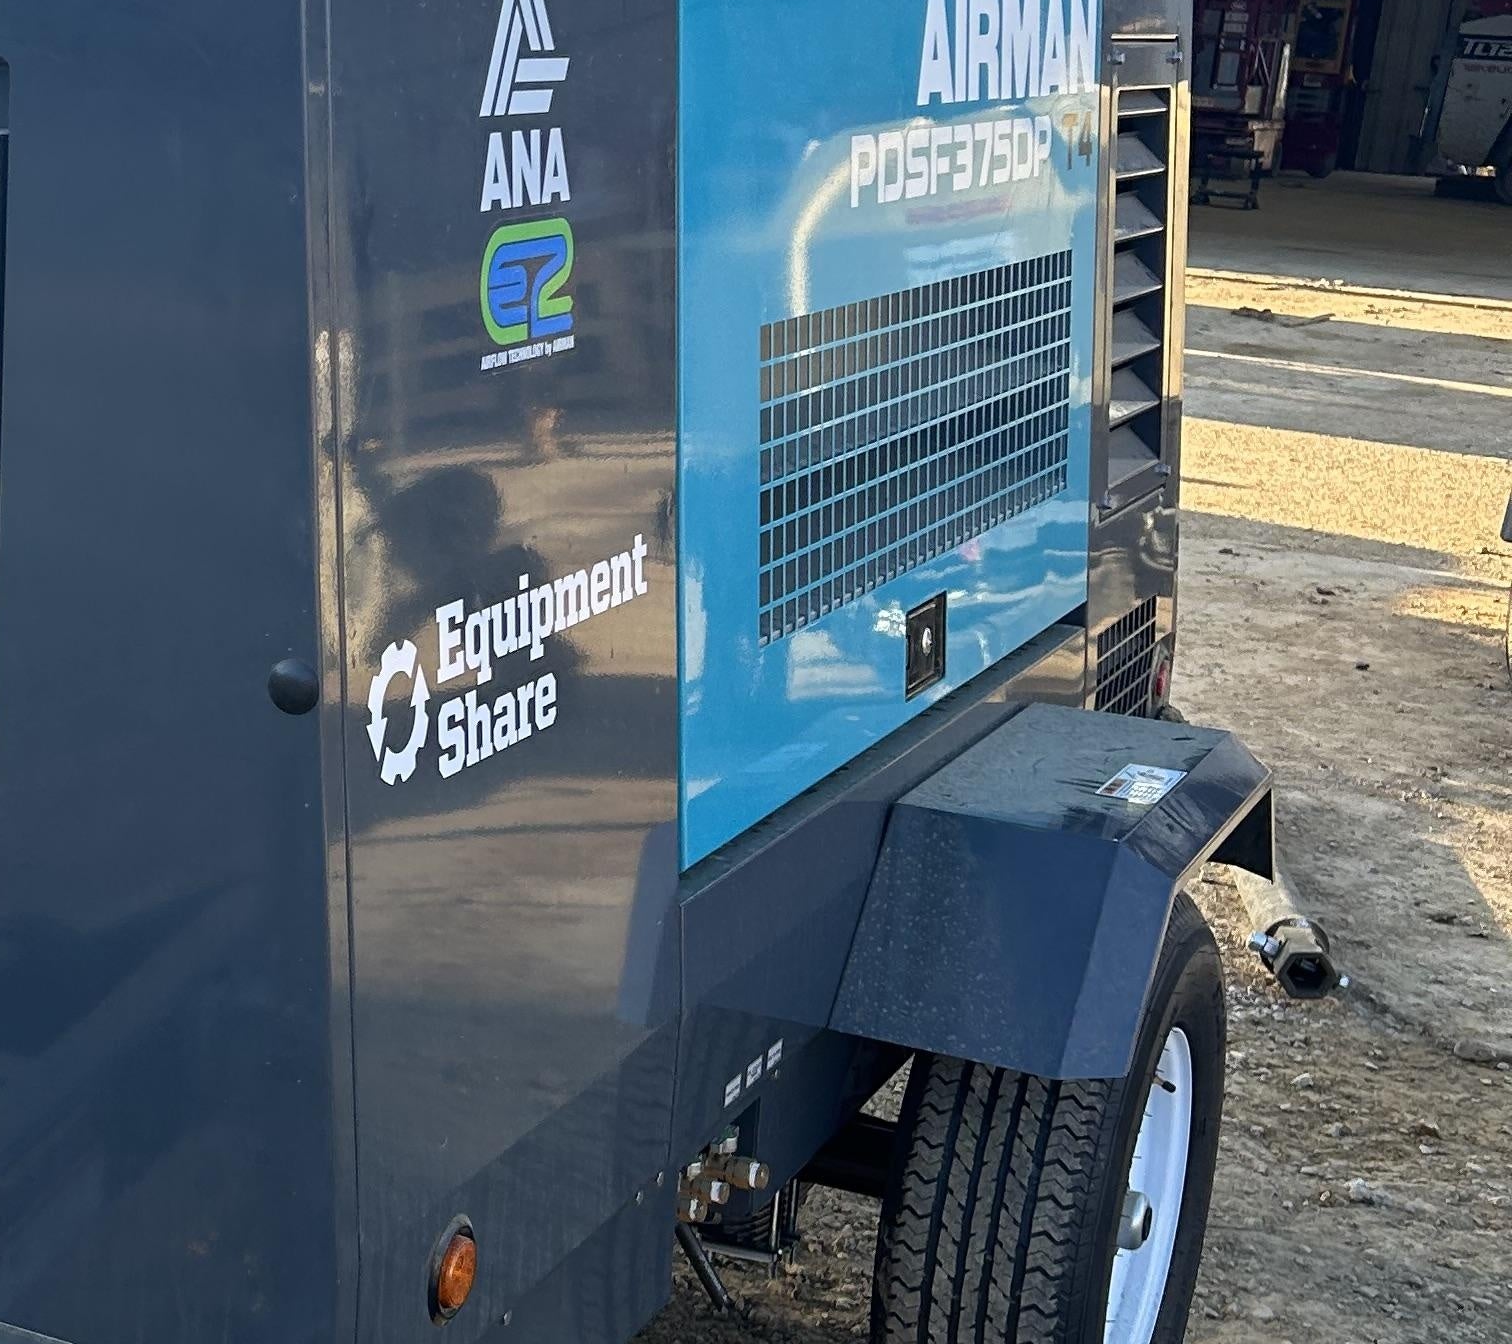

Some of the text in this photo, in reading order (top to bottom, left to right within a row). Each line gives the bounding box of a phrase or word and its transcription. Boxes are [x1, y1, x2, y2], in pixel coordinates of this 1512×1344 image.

[479, 127, 571, 212] ANA
[850, 115, 1054, 208] PDSF375DP
[435, 532, 648, 687] Equipment
[438, 672, 557, 779] Share
